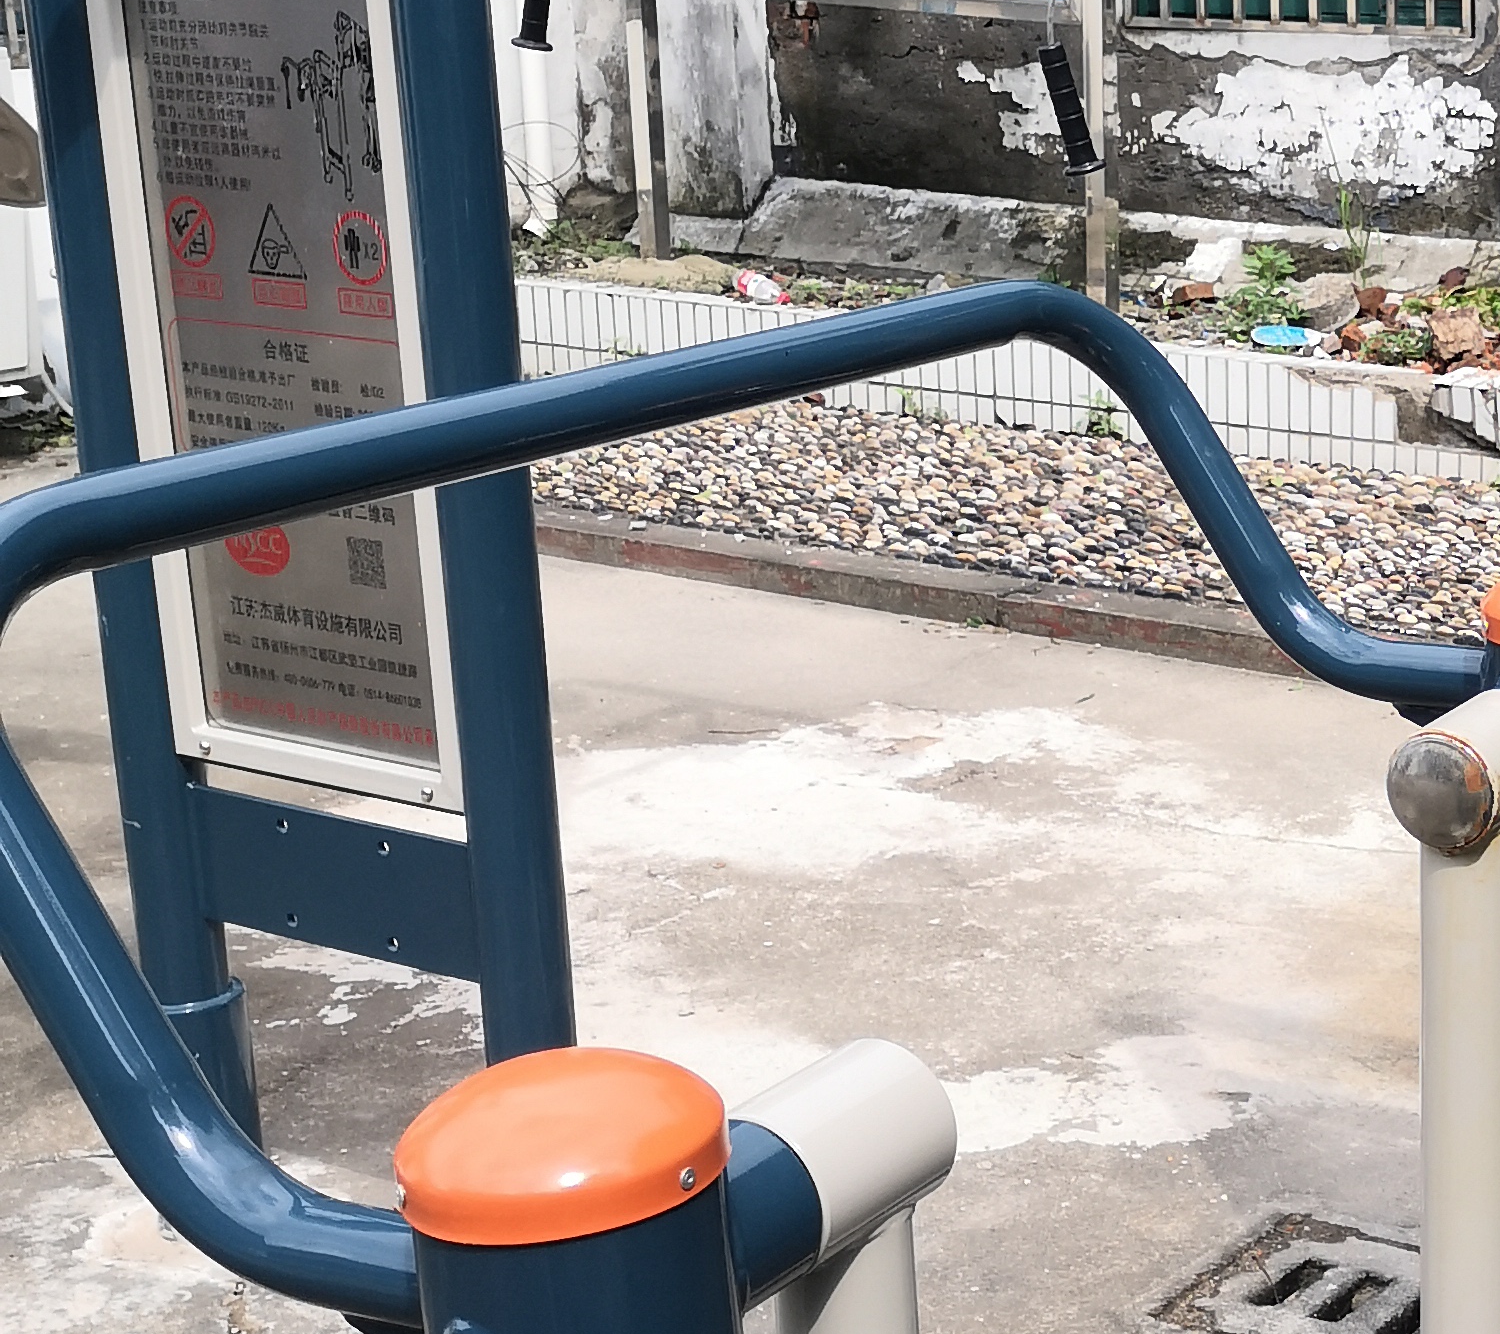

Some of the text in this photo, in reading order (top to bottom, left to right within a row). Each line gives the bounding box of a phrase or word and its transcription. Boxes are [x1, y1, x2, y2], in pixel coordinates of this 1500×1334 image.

[262, 338, 311, 364] 合格证
[229, 593, 404, 646] 江苏杰威体育设施有限公司
